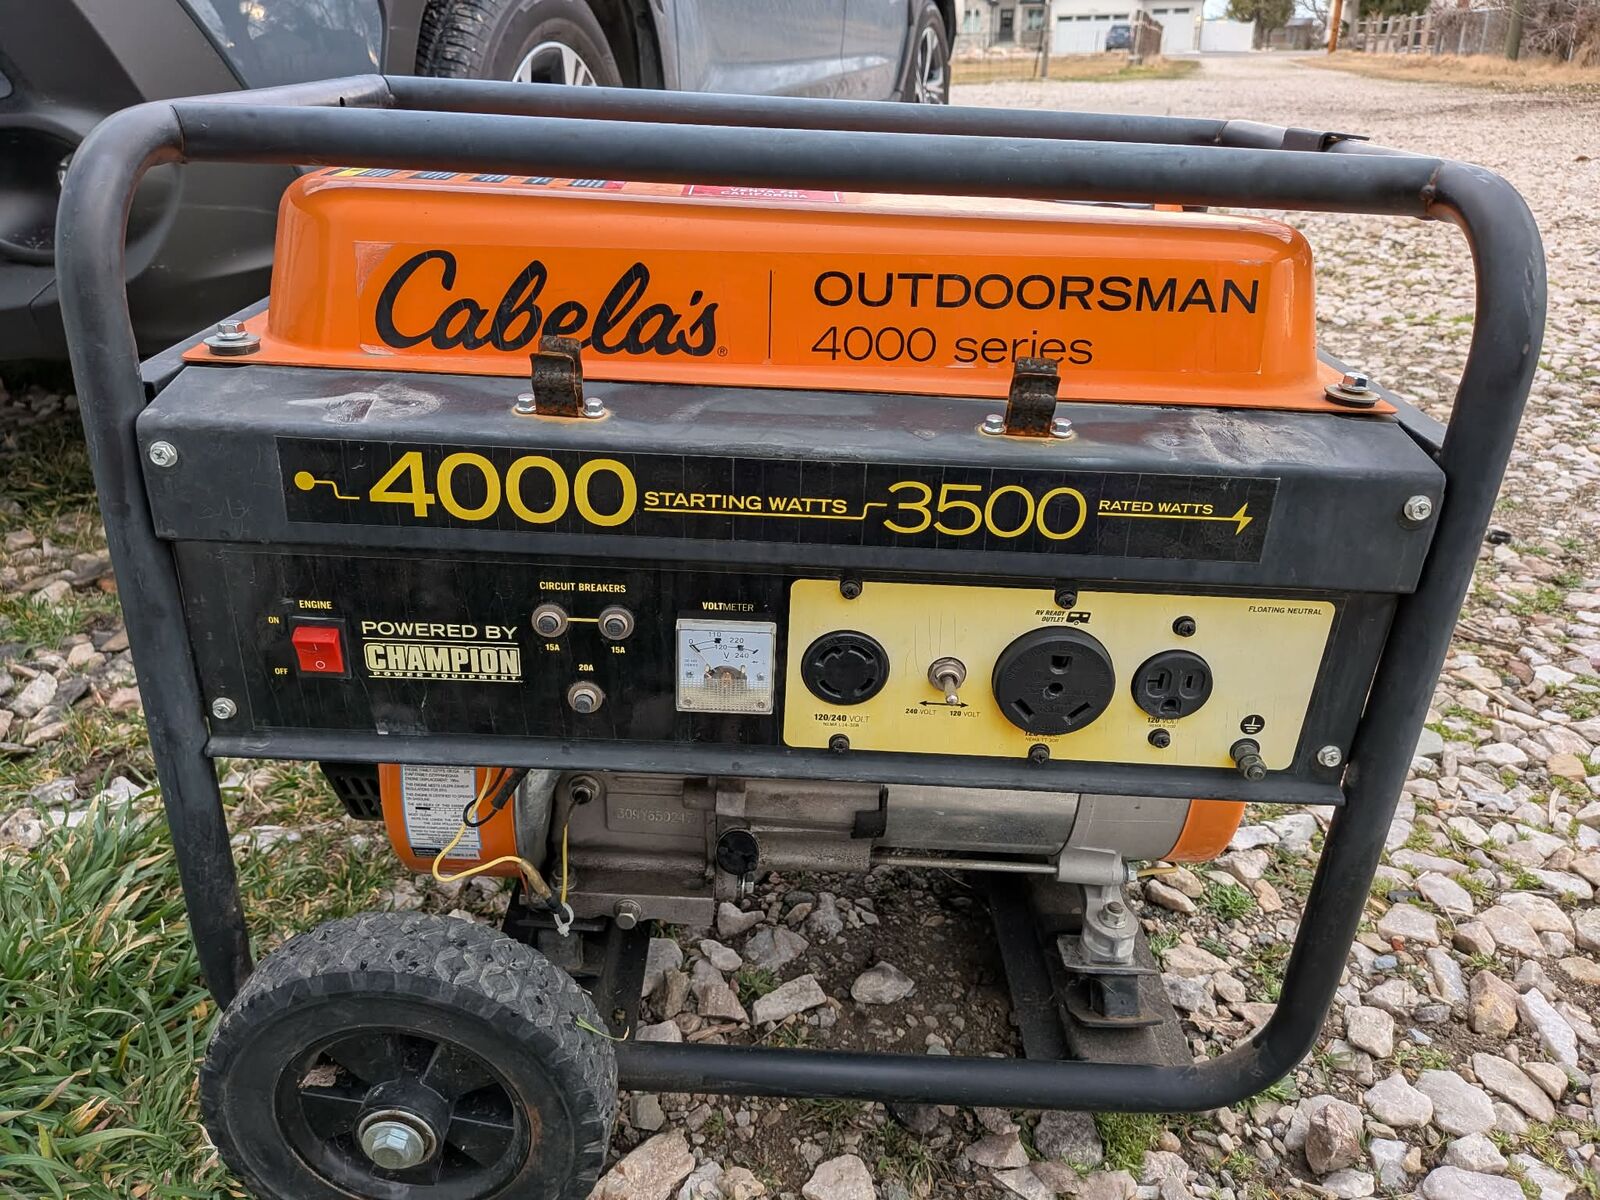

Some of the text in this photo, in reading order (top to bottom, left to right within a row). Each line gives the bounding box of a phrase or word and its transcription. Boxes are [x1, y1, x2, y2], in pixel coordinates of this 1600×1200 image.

[720, 190, 809, 199] CALIFORNIA
[813, 270, 1259, 314] OUTDOORSMAN
[375, 250, 719, 357] Cabela's
[811, 326, 1094, 365] 4000 series
[369, 451, 1214, 540] 4000 STARTING WATTS 3500 RATED WATTS
[539, 581, 627, 593] CIRCUIT BREAKERS
[299, 600, 333, 610] ENGINE
[702, 602, 755, 612] VOLTMETER
[1248, 605, 1322, 615] FLOATING NEUTRAL
[1045, 609, 1067, 617] READY
[268, 616, 280, 624] ON
[361, 621, 518, 640] POWERED BY
[545, 643, 560, 651] 15A
[611, 646, 626, 654] 15A
[366, 643, 520, 676] CHAMPION
[723, 652, 730, 660] V
[274, 667, 288, 675] OFF
[578, 664, 594, 672] 20A
[431, 673, 517, 681] EQUIPMENT
[814, 713, 870, 723] 120/240 VOLT
[1147, 715, 1160, 723] 120
